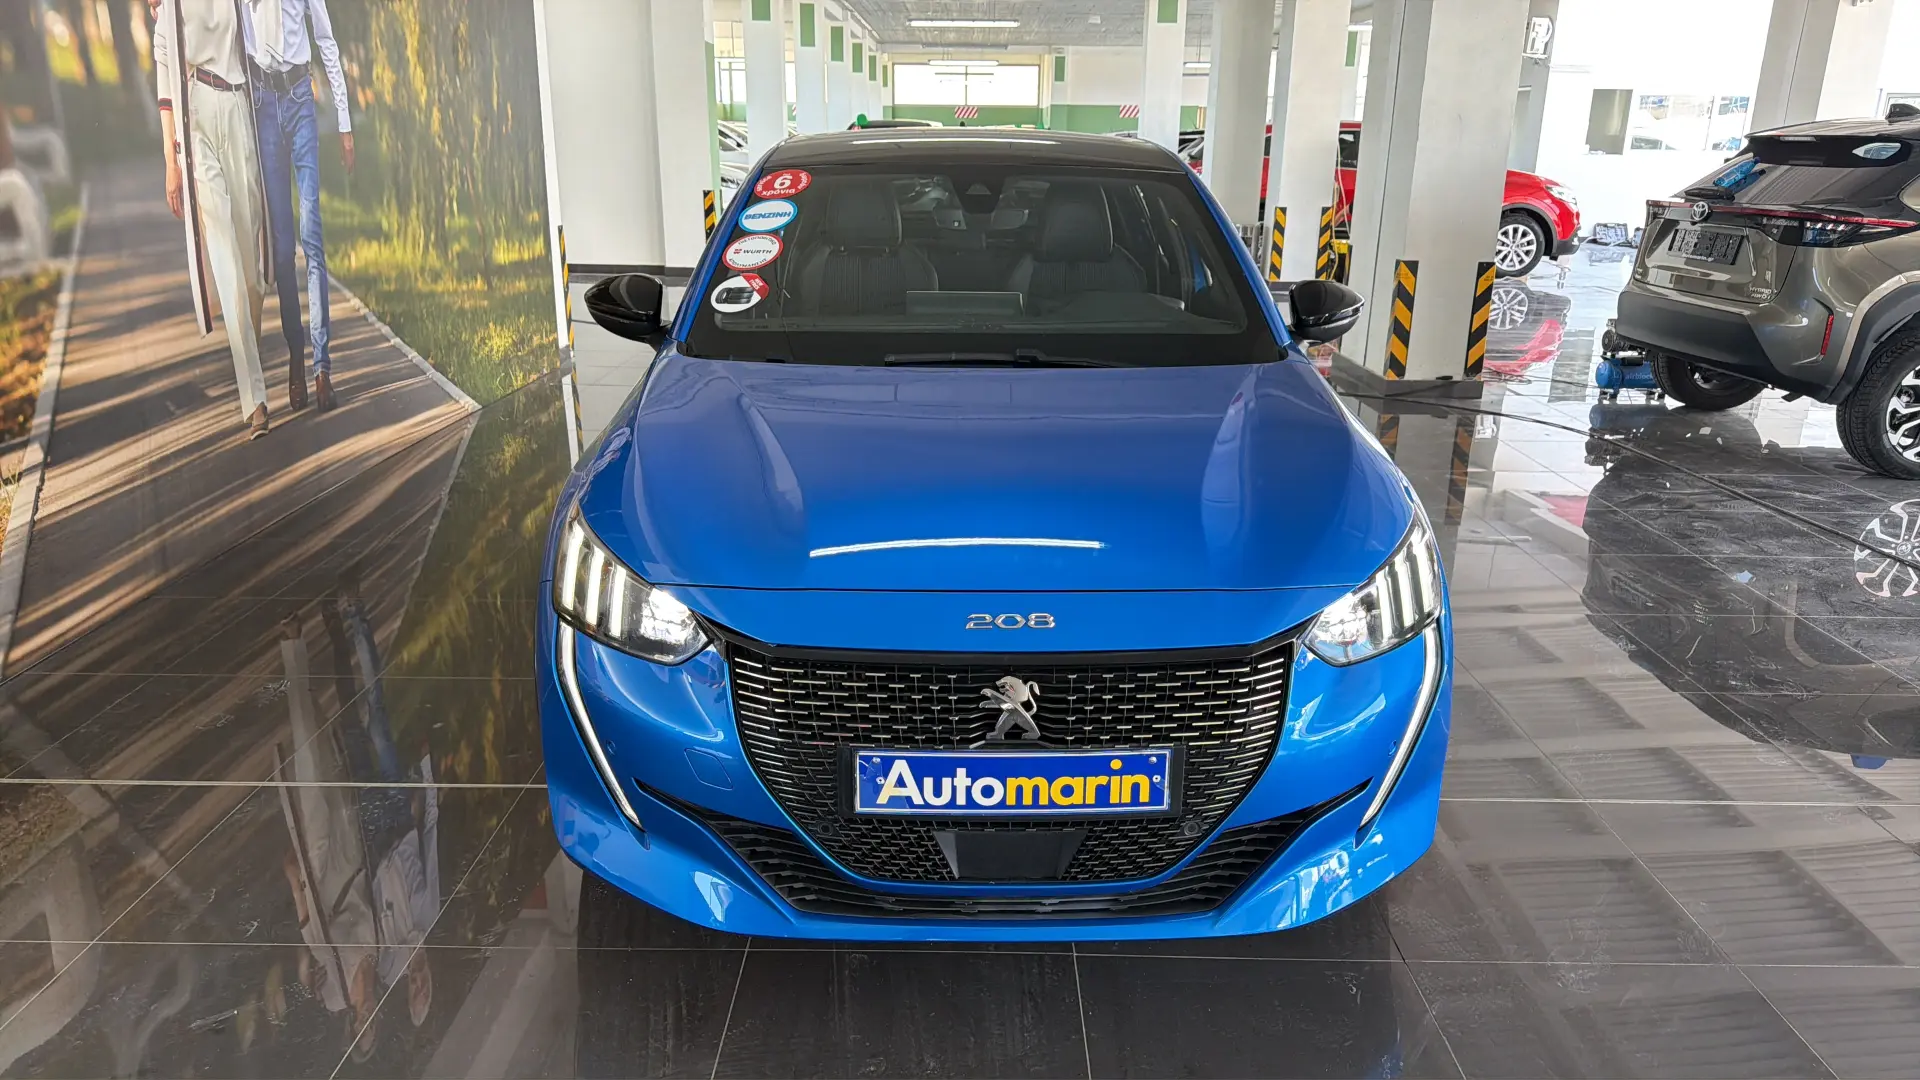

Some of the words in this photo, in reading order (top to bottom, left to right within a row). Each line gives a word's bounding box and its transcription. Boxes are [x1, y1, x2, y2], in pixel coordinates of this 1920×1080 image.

[773, 175, 793, 189] 6
[761, 188, 795, 196] χρόνια
[965, 612, 1056, 630] 208
[876, 758, 1150, 807] Automarin
